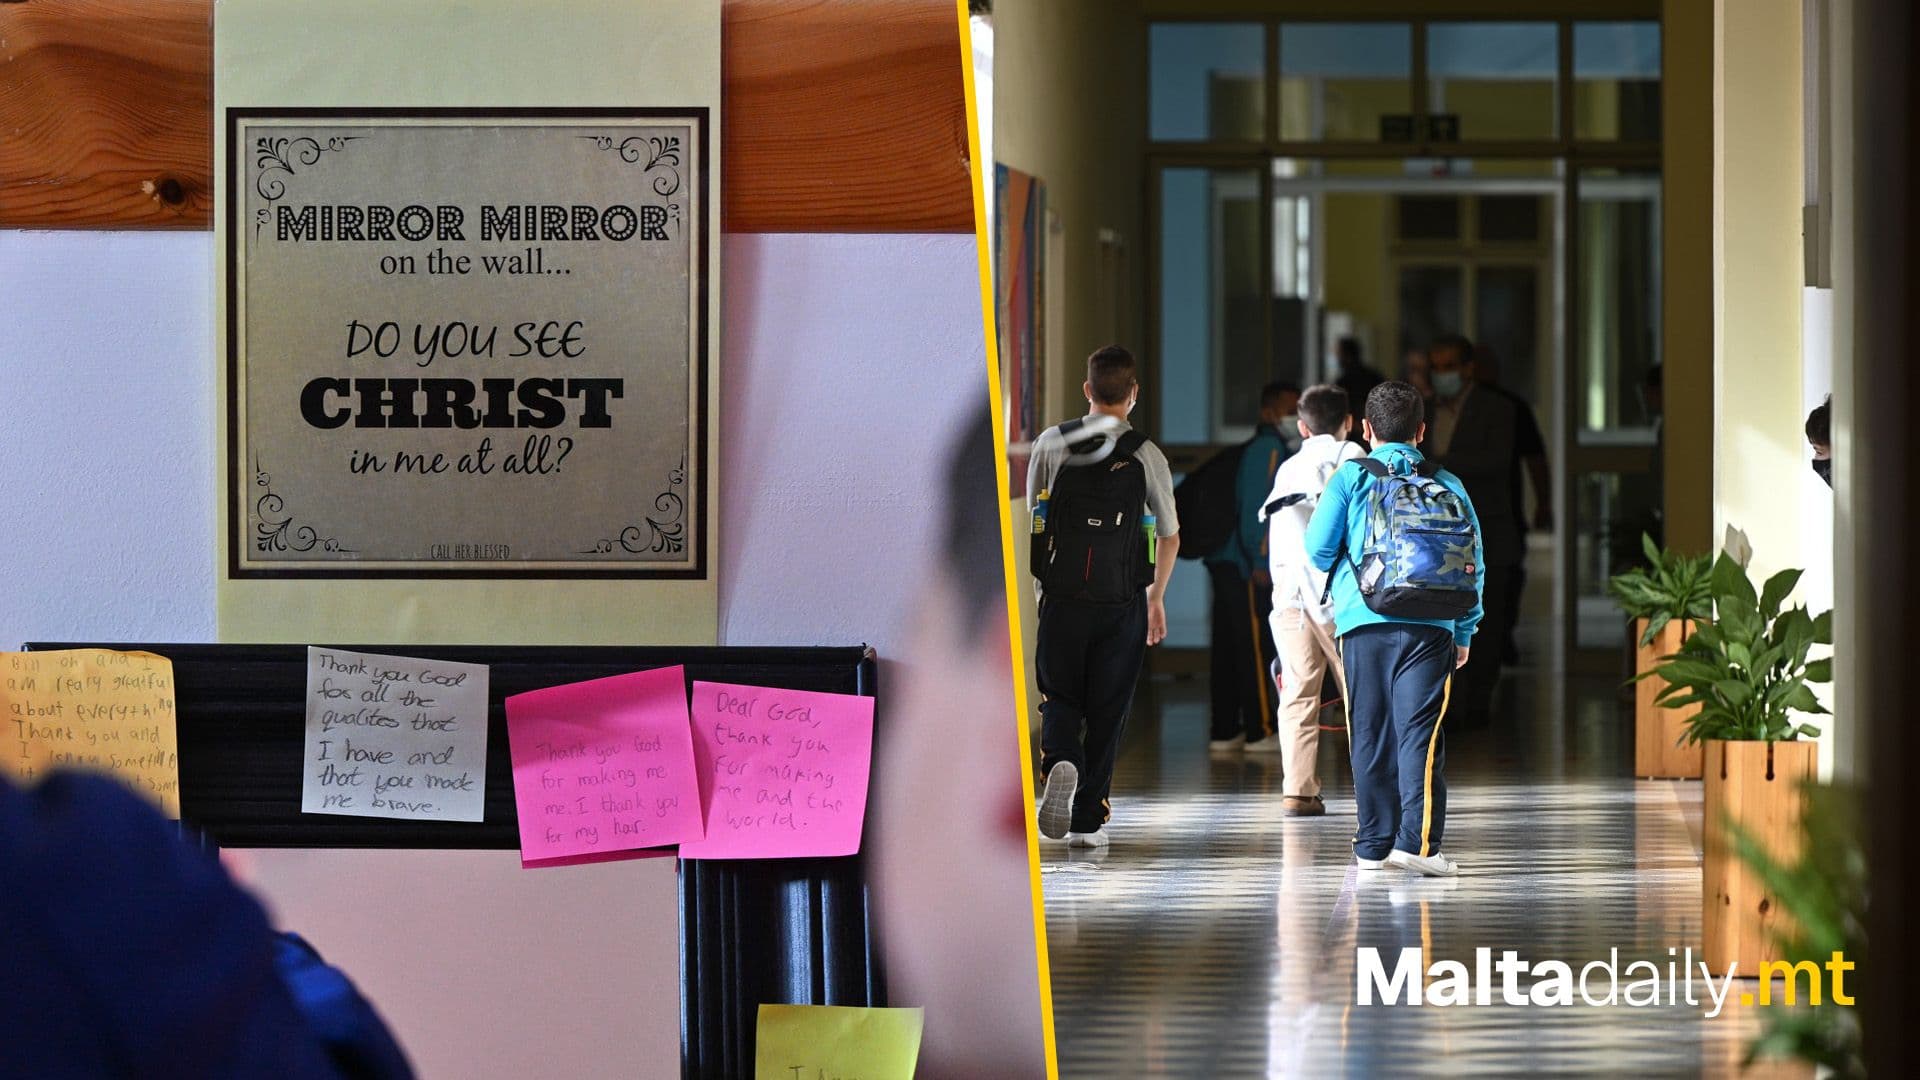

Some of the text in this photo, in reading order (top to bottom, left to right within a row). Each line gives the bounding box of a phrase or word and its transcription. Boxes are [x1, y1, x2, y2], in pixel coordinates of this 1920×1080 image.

[277, 205, 670, 242] MIRROR MIRROR
[380, 248, 571, 275] on the wall...
[346, 319, 586, 367] DO YOU SEE
[300, 377, 624, 429] CHRIST
[350, 435, 573, 474] in me at all?
[430, 543, 510, 560] CALL HER BLESSED
[320, 654, 467, 687] Thank you God
[361, 684, 390, 702] all
[400, 691, 437, 708] the
[10, 701, 64, 718] about
[411, 713, 457, 731] that
[716, 692, 822, 729] Dear God,
[11, 719, 160, 744] Thank you and
[18, 741, 31, 758] I
[318, 738, 454, 765] I have and
[536, 735, 662, 765] Thank you God
[788, 735, 830, 758] you
[318, 764, 474, 794] that you made
[542, 766, 666, 790] for making me
[765, 764, 834, 789] making
[322, 794, 441, 813] me brave.
[576, 796, 588, 814] I
[602, 792, 645, 813] thank
[656, 795, 679, 818] you
[719, 785, 843, 813] me and the
[545, 827, 565, 843] for
[576, 826, 599, 845] my
